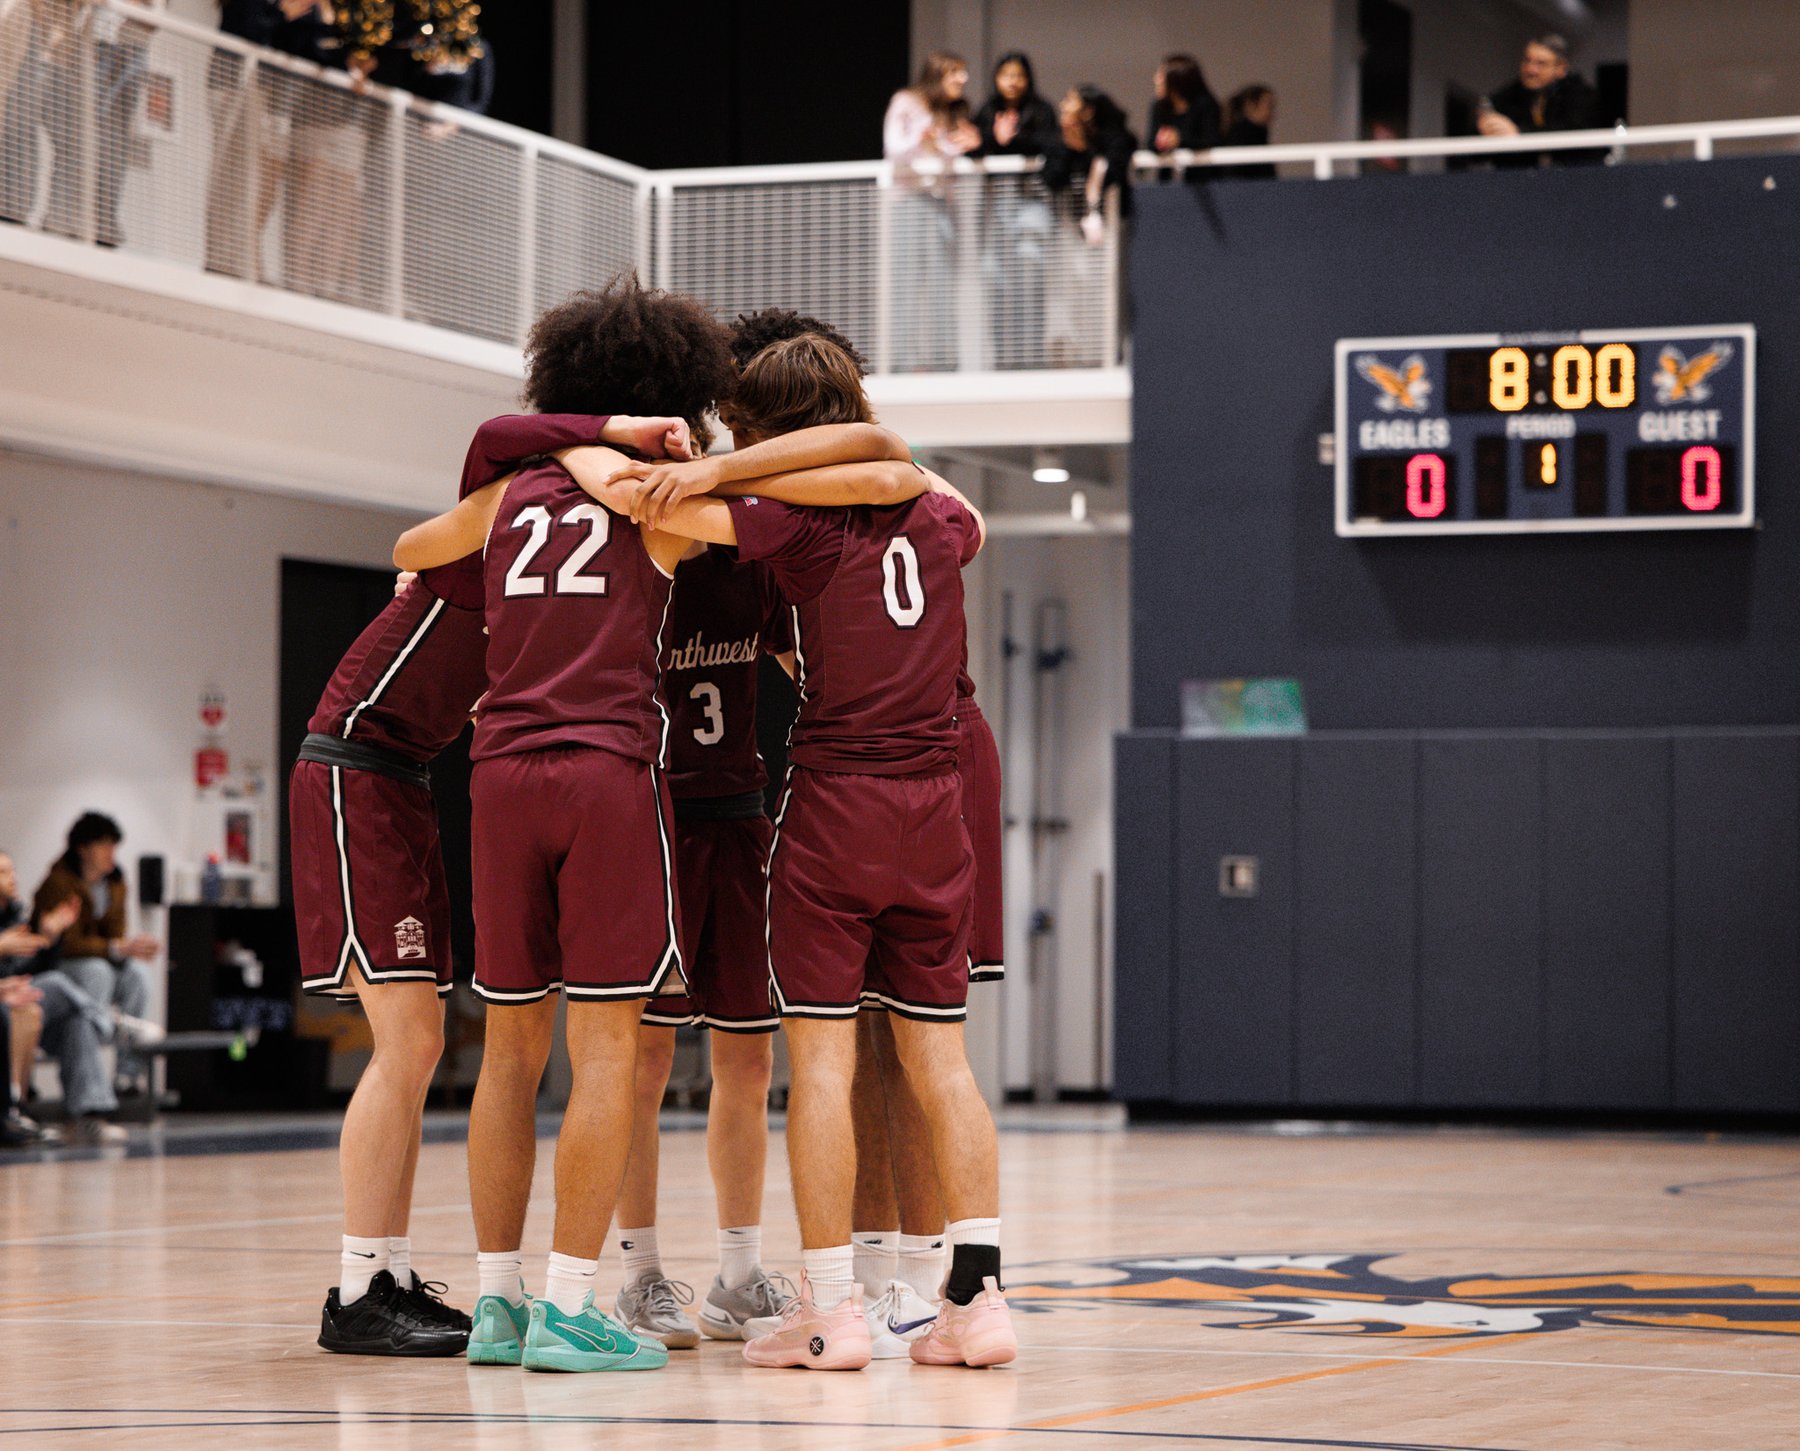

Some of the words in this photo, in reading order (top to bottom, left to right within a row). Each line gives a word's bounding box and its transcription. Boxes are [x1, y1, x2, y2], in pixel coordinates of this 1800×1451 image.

[1489, 343, 1636, 411] 8:00
[1359, 418, 1451, 451] EAGLES
[1506, 413, 1576, 439] PERIOD
[1639, 409, 1722, 442] GUEST
[1406, 454, 1446, 518] 0
[1540, 443, 1557, 485] 1
[1681, 445, 1722, 511] 0
[504, 504, 611, 598] 22
[881, 535, 927, 629] 0
[667, 630, 759, 671] rthwest
[689, 681, 725, 746] 3
